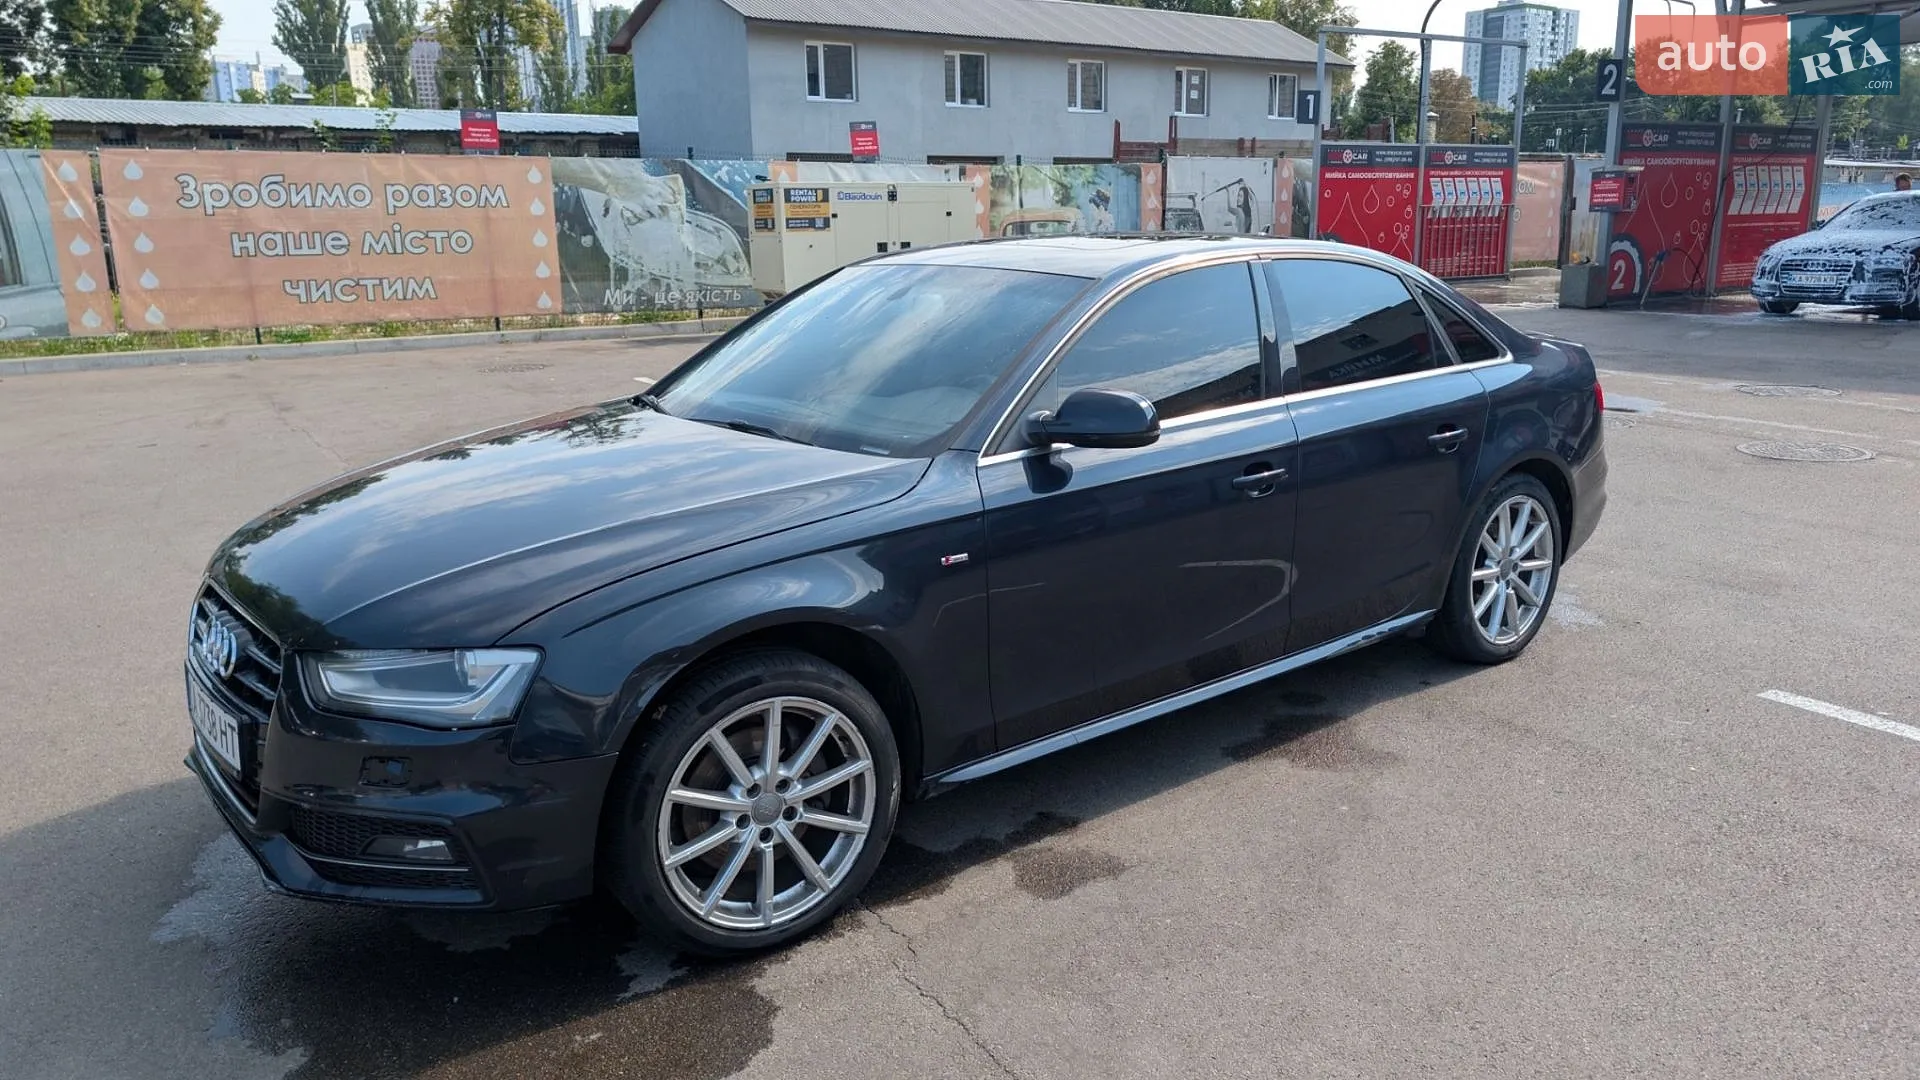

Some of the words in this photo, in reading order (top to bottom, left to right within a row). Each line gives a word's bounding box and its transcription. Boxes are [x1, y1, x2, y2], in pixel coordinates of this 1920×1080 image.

[1601, 63, 1618, 95] 2
[1305, 94, 1315, 119] 1
[175, 173, 373, 216] Зробимо
[384, 182, 510, 215] разом
[230, 230, 350, 258] наше
[361, 222, 474, 255] місто
[282, 276, 438, 304] чистим
[1611, 259, 1626, 290] 2
[603, 288, 634, 305] Ми
[654, 291, 681, 305] це
[686, 286, 742, 302] якість
